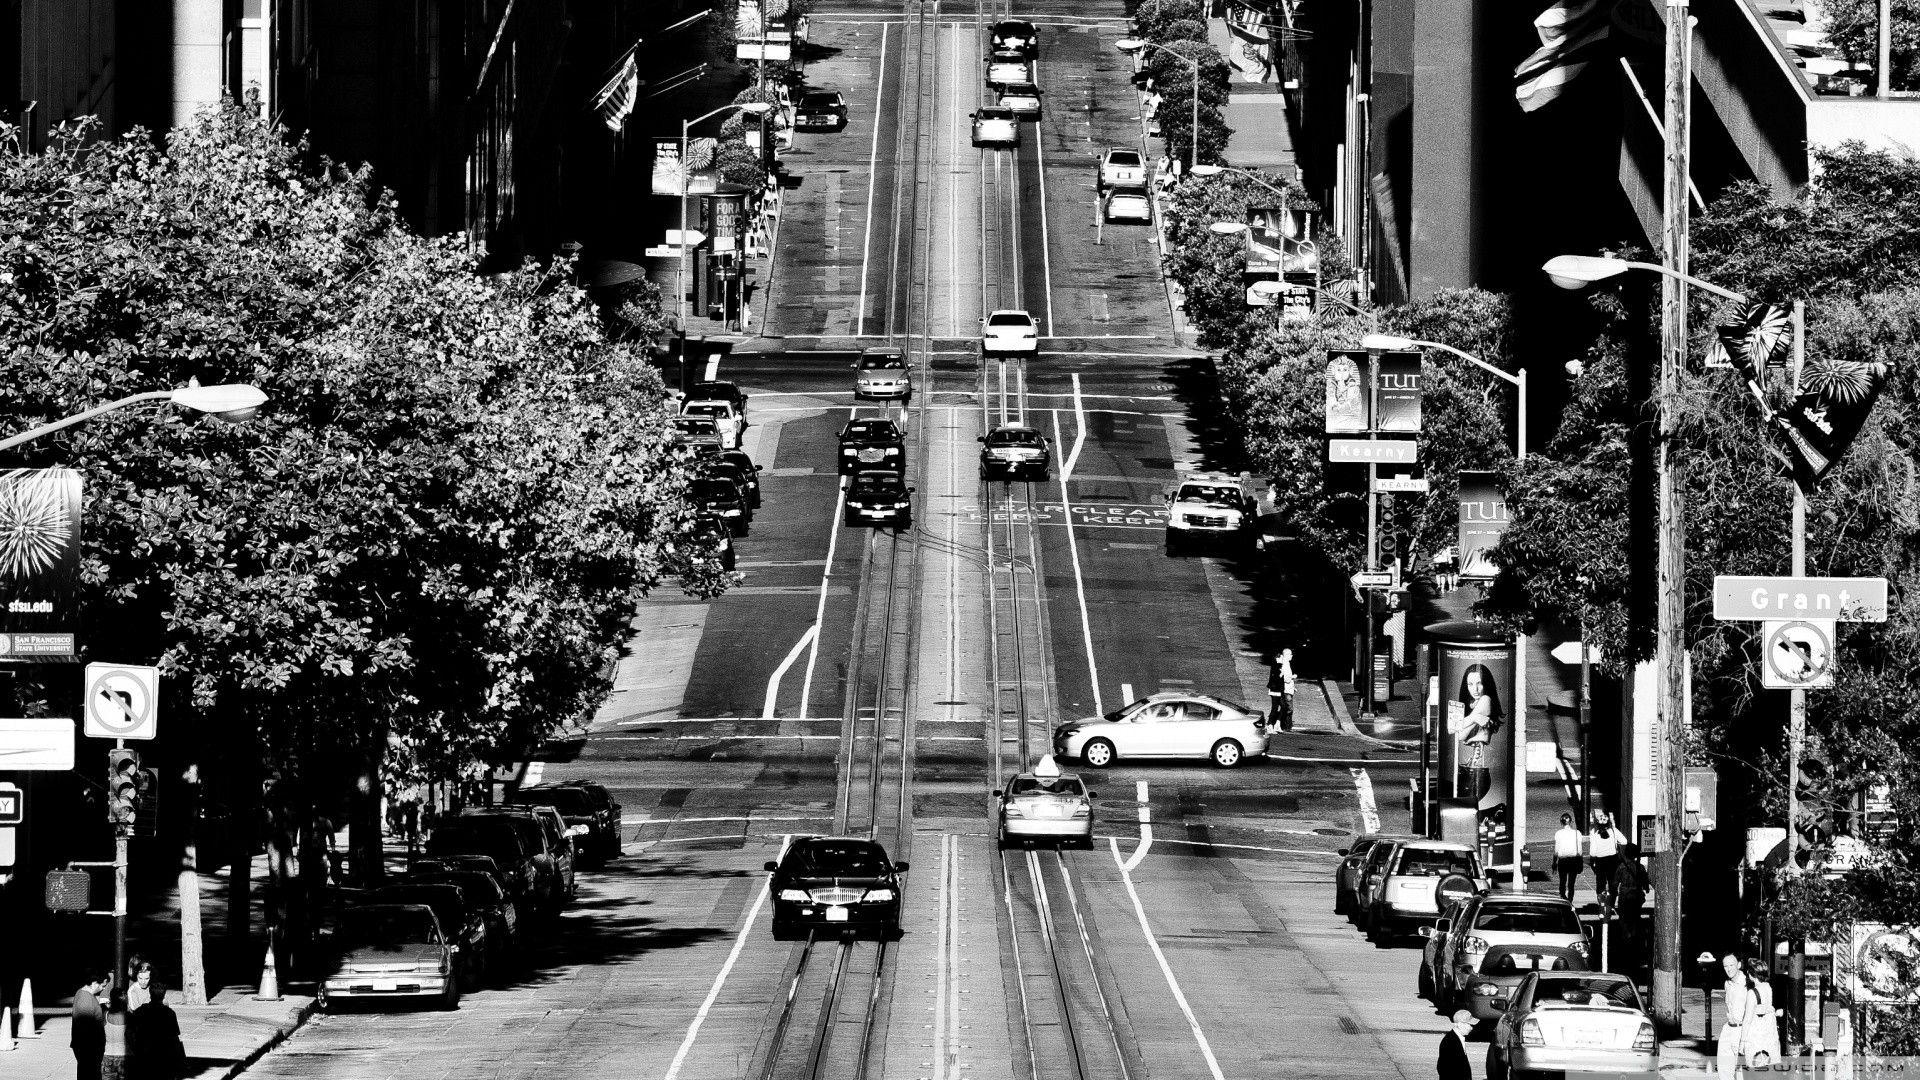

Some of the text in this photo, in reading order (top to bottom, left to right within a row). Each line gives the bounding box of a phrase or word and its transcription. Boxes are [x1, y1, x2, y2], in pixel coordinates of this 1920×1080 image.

[716, 202, 740, 214] FOR A
[716, 214, 736, 227] GOO
[716, 227, 735, 237] TIM
[1380, 374, 1420, 388] TUT
[1340, 445, 1405, 459] Kearny
[1460, 501, 1508, 520] TUT
[1083, 515, 1164, 525] KEEP
[1751, 587, 1851, 610] Grant
[8, 599, 54, 613] sfsu.edu
[15, 635, 71, 643] SAN FRANCISCO
[1826, 854, 1869, 865] GRAN
